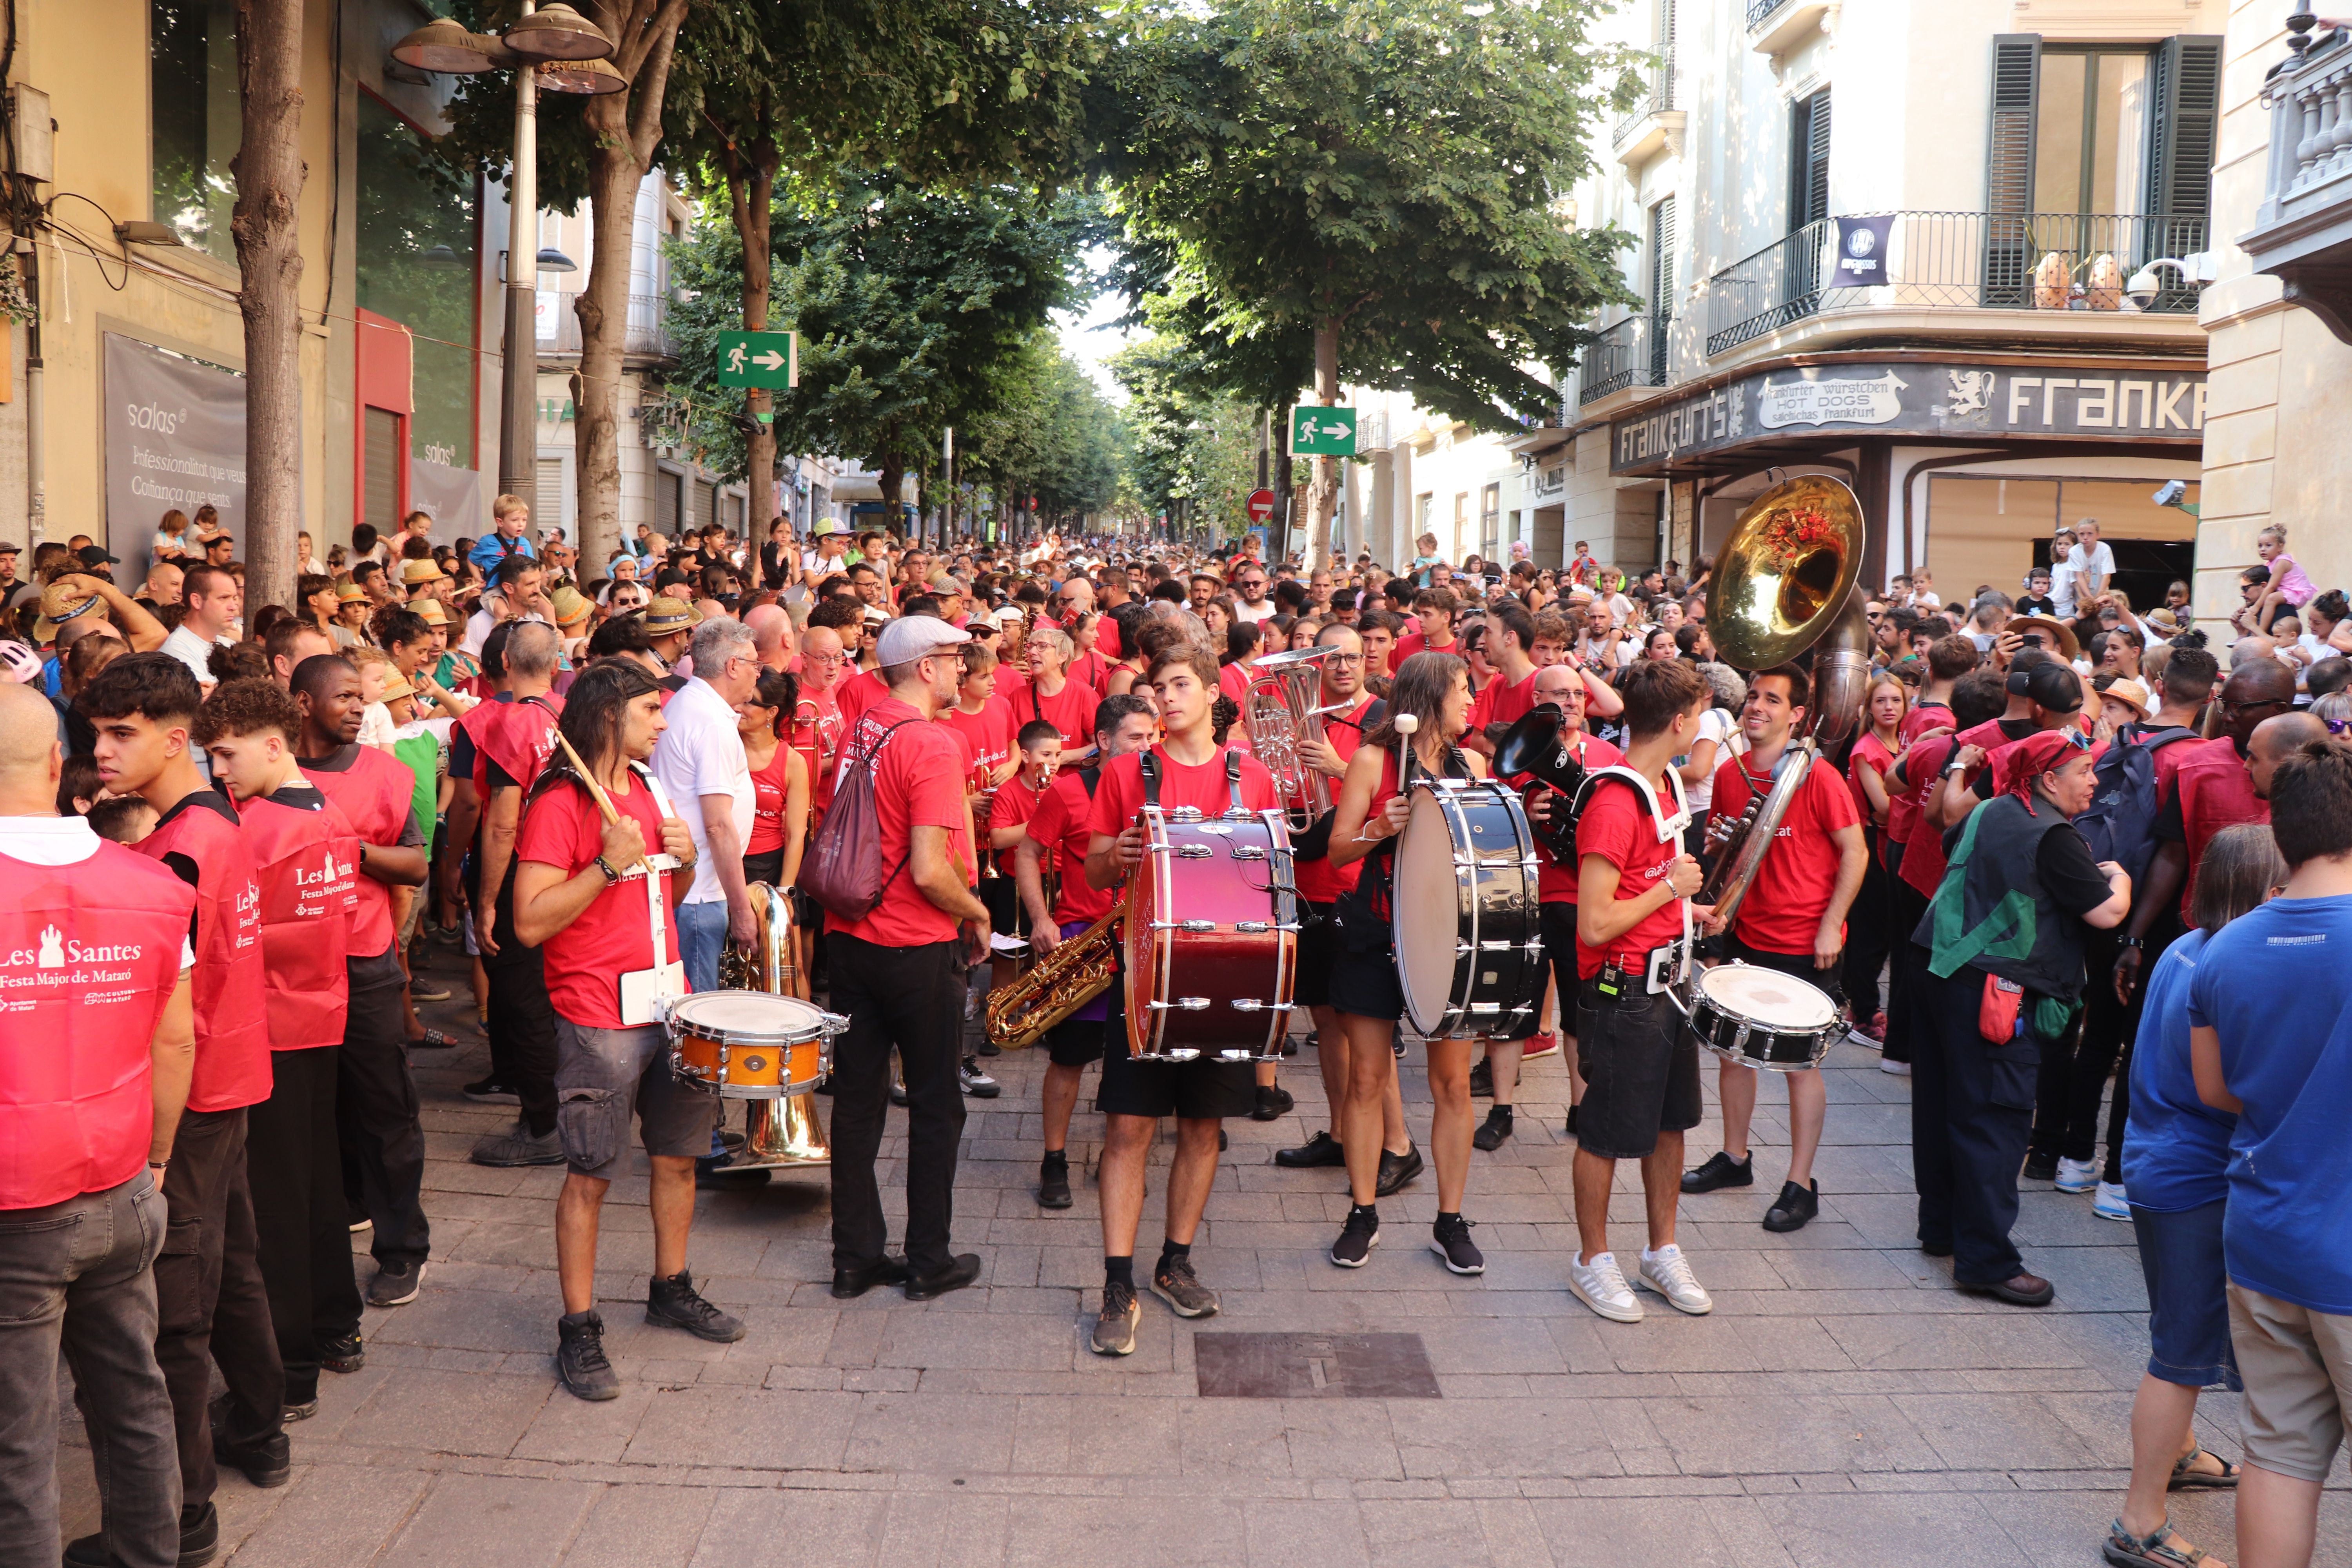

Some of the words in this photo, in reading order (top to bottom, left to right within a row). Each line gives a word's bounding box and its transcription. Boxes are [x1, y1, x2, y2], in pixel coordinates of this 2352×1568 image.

[1777, 398, 1808, 410] HOT
[1818, 395, 1870, 407] DOGS
[209, 465, 225, 484] que
[186, 490, 206, 508] que
[296, 868, 323, 886] Les
[301, 890, 323, 899] Festa
[68, 940, 141, 963] Santes
[0, 974, 34, 988] Festa
[36, 973, 69, 988] Major
[71, 970, 88, 983] de
[92, 968, 131, 982] Mataró
